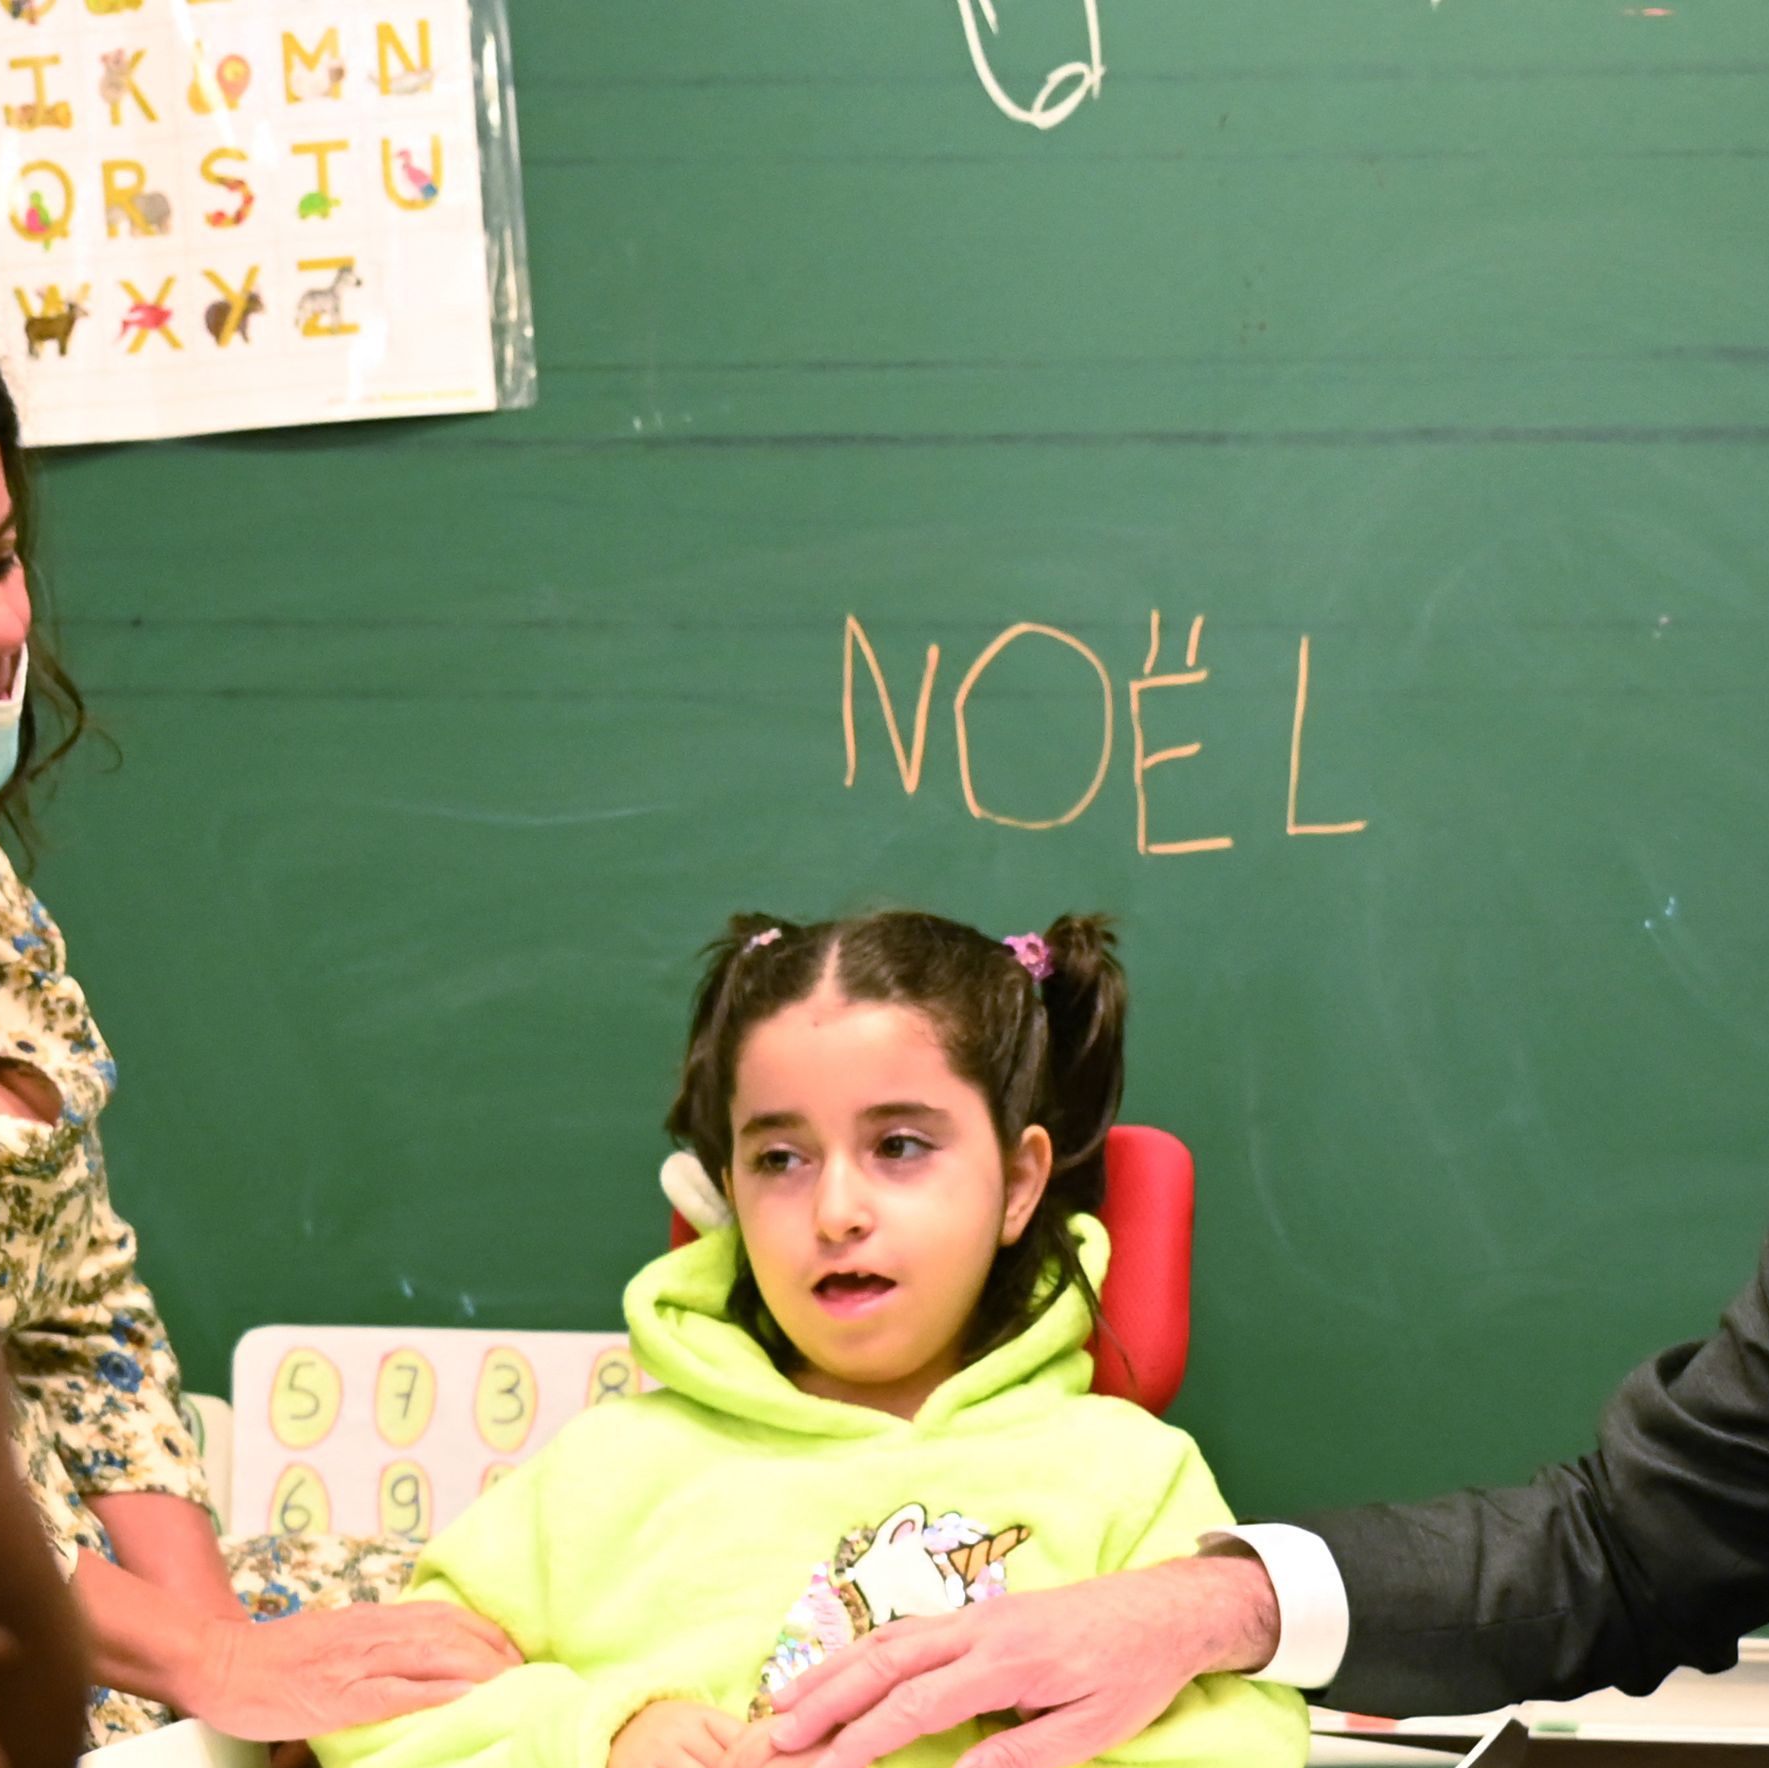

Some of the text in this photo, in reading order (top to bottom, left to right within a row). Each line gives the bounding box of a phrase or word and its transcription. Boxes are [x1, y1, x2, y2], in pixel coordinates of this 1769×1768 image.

[102, 49, 159, 125] K
[282, 27, 342, 104] M
[376, 19, 431, 95] N
[10, 160, 74, 242] Q
[102, 160, 156, 238] R
[200, 147, 254, 227] S
[291, 139, 350, 218] T
[382, 134, 443, 211] U
[120, 276, 184, 353] X
[202, 264, 261, 347] Y
[297, 257, 360, 337] Z
[843, 608, 1368, 856] NOËL
[288, 1361, 321, 1421] 5
[394, 1363, 420, 1420] 7
[491, 1363, 525, 1425] 3
[280, 1473, 422, 1536] 6 9
